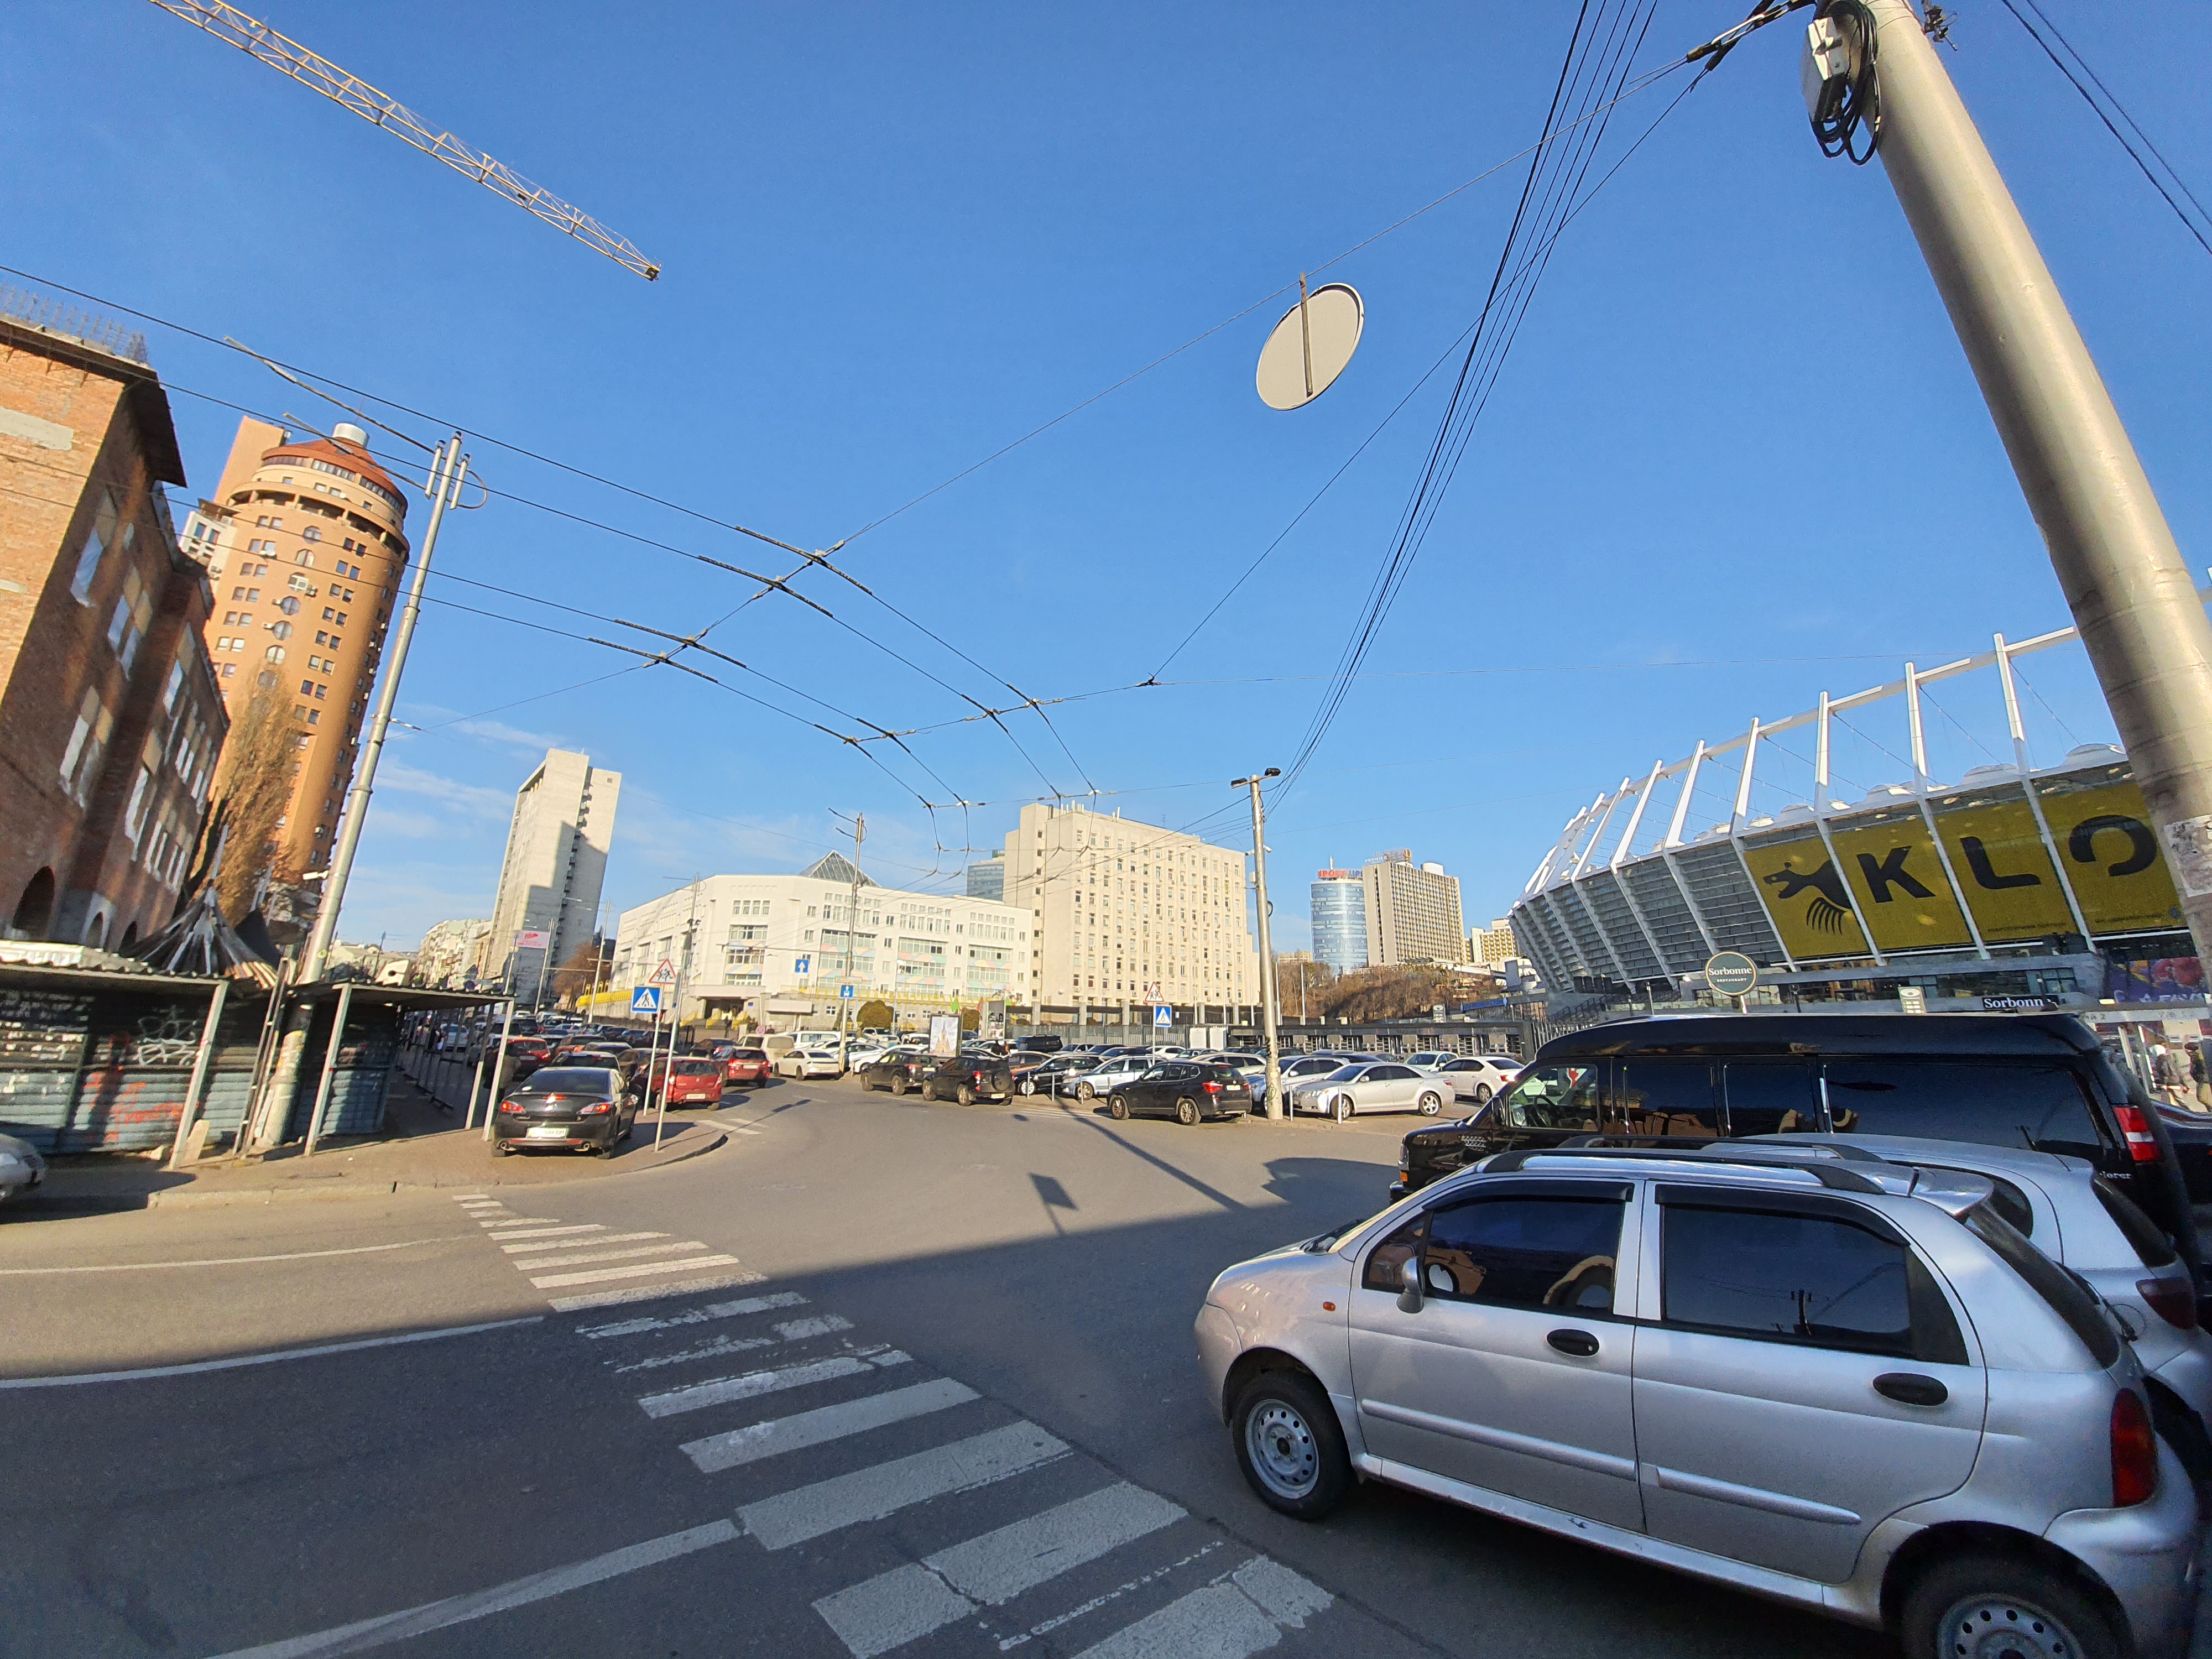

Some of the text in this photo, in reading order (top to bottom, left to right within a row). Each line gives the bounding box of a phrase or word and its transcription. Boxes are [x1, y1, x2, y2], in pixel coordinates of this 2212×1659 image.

[1856, 814, 2158, 904] KLO
[1318, 869, 1347, 878] SPORT
[1708, 967, 1752, 975] Sorbonne
[1984, 997, 2052, 1009] Sorbonn
